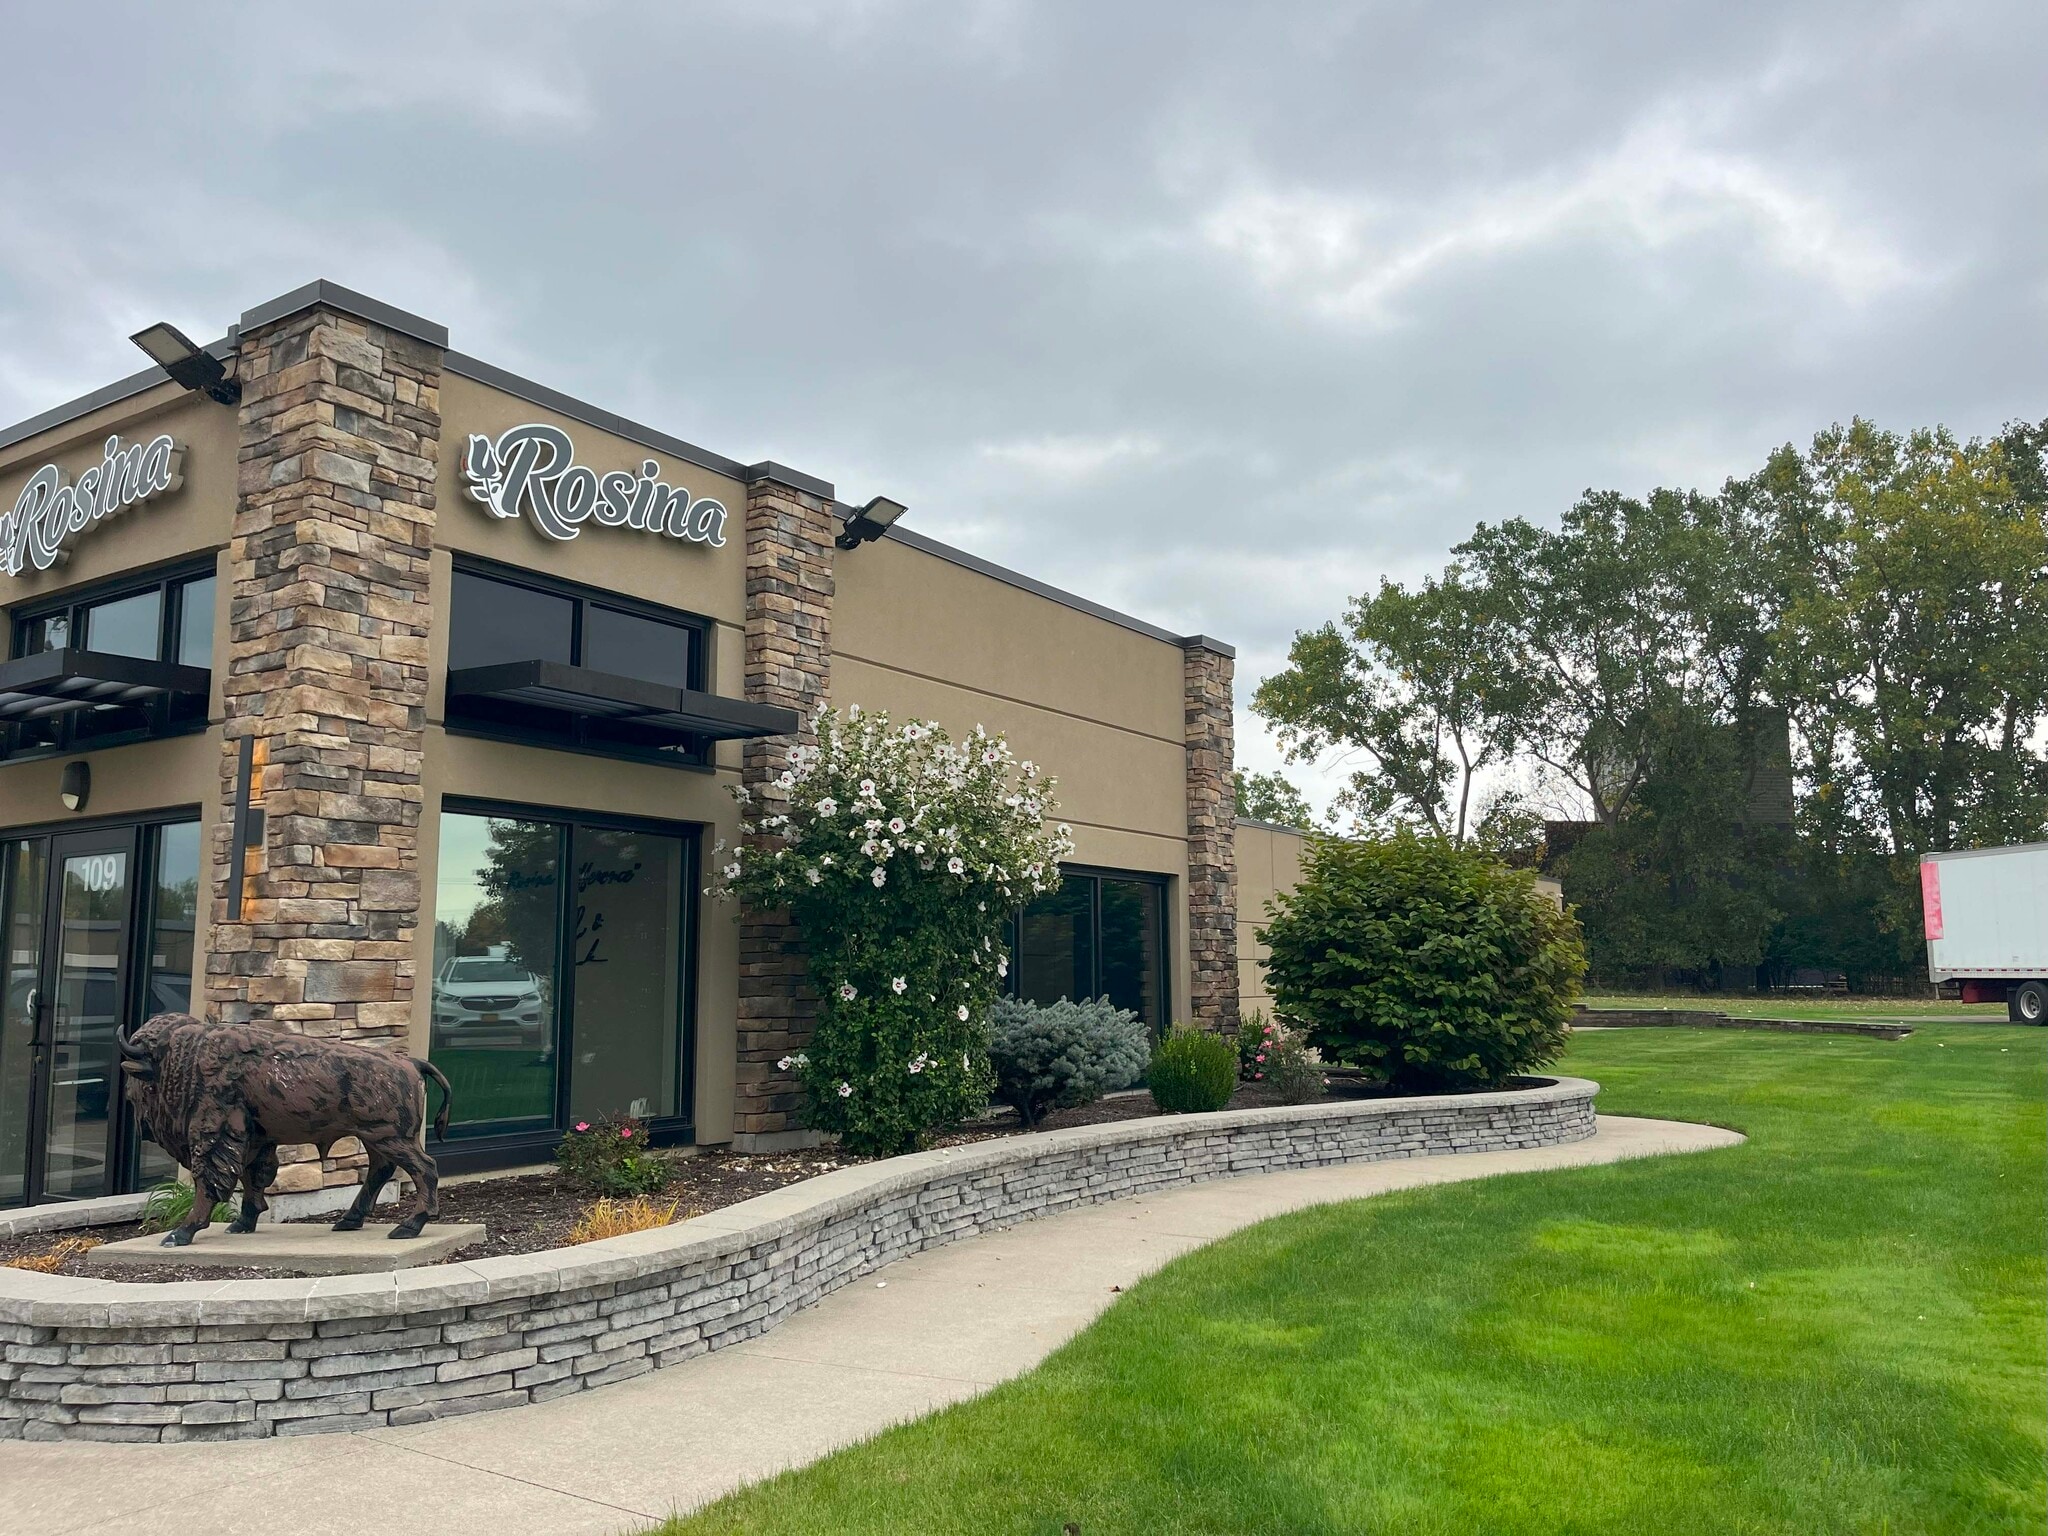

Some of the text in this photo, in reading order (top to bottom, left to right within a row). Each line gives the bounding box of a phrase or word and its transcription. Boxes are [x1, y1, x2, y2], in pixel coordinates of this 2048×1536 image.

[13, 434, 174, 577] Rosina
[495, 423, 728, 548] Rosina
[81, 856, 117, 892] 109
